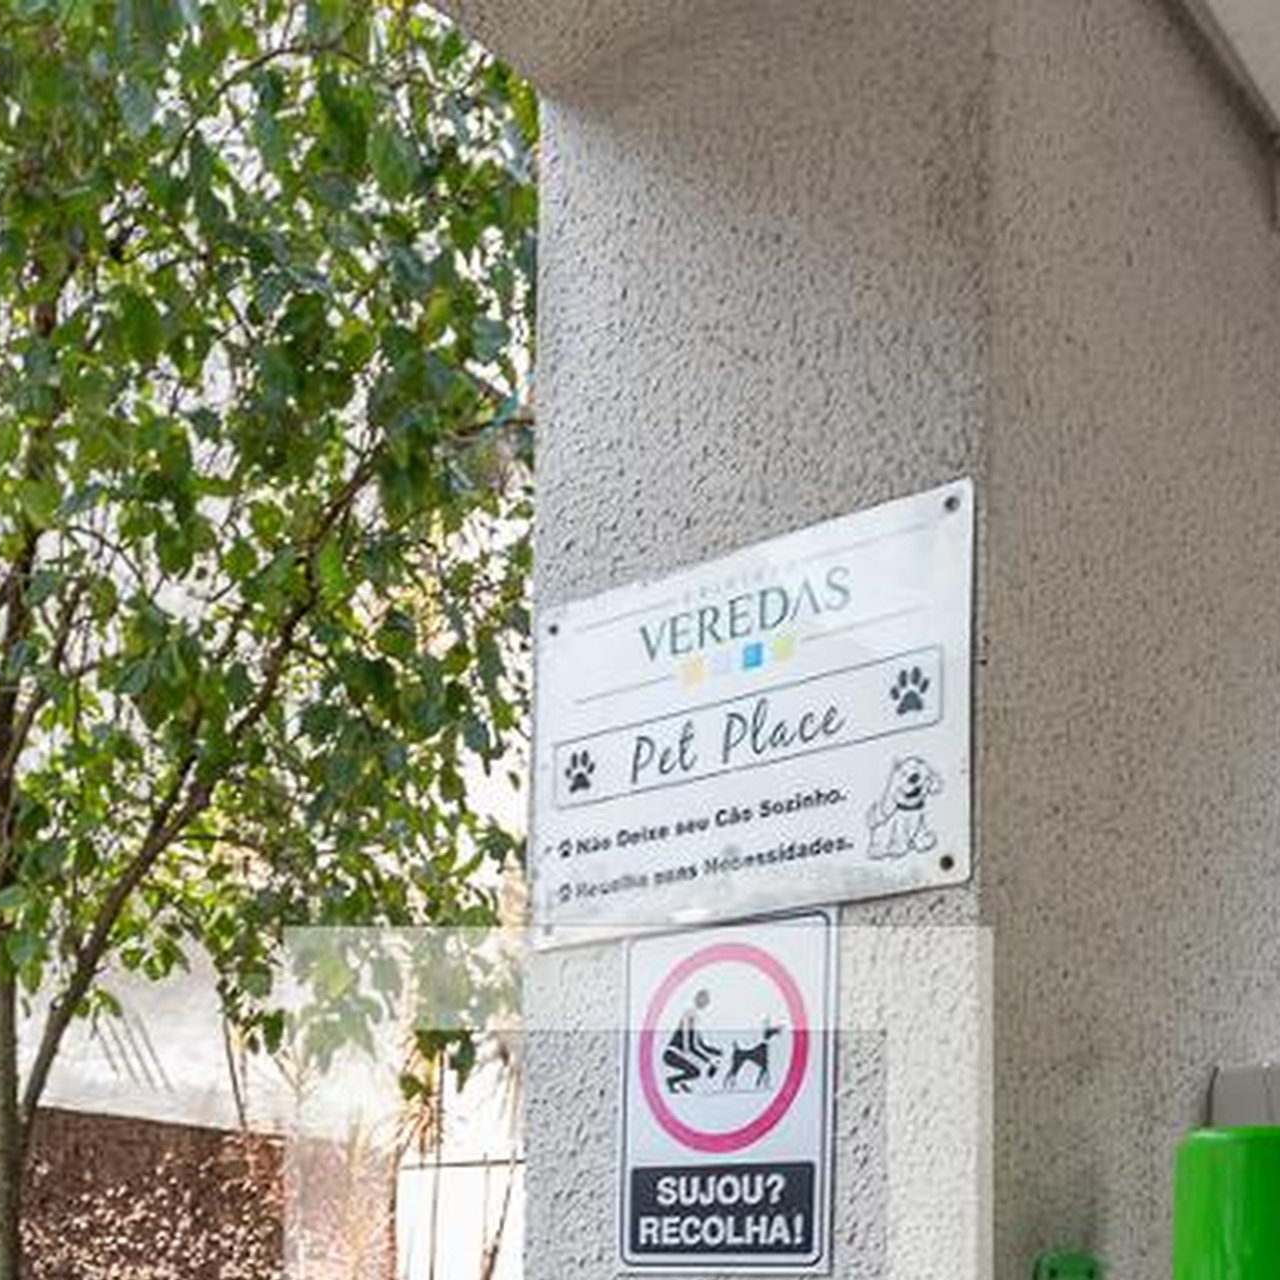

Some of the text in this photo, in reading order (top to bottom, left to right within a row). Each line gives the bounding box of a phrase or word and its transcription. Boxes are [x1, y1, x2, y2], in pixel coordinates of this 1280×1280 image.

[639, 565, 851, 661] VEREDAS
[631, 697, 848, 785] Pet Place
[616, 824, 669, 848] Deixe
[675, 817, 710, 835] seu
[715, 806, 754, 827] Cão
[759, 788, 848, 819] Sozinho.
[656, 1173, 786, 1206] SUJOU?
[639, 1213, 804, 1246] RECOLHA!
